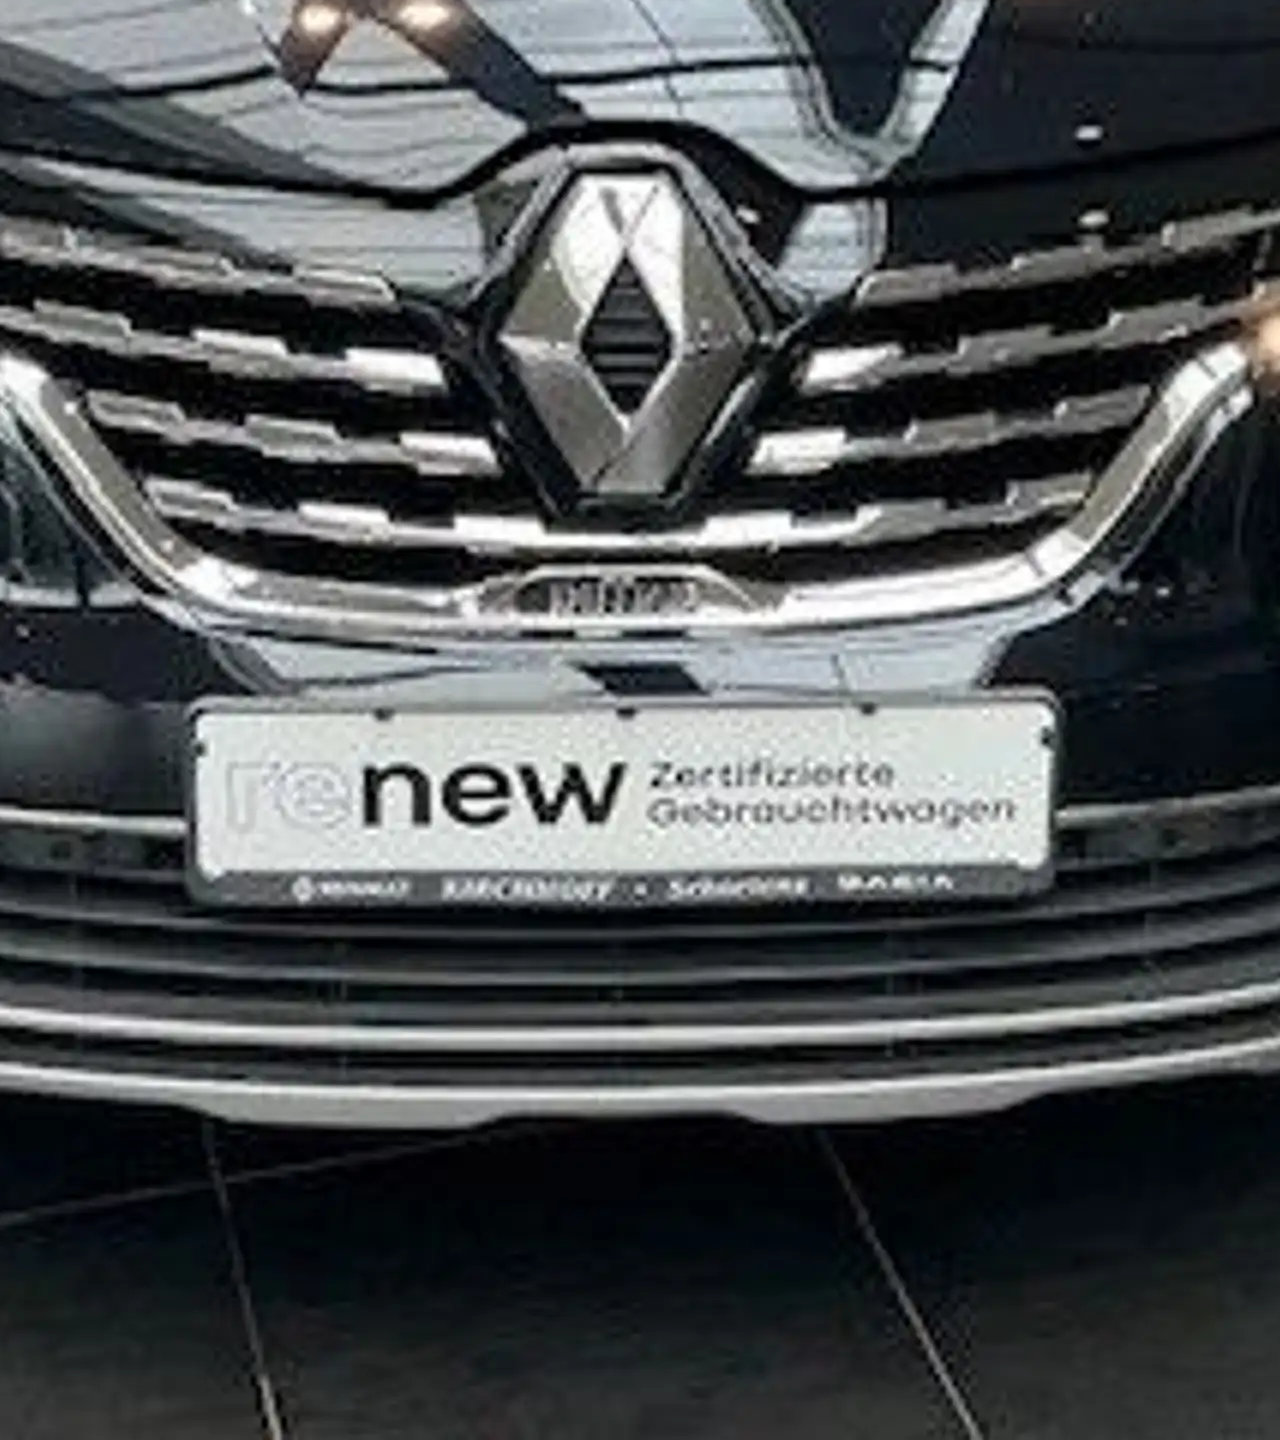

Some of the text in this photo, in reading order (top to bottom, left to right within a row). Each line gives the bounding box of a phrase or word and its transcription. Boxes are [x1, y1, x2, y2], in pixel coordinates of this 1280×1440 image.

[649, 758, 896, 788] Zertifizierte
[225, 761, 628, 832] renew
[645, 794, 1018, 829] Gebrauchtwagen
